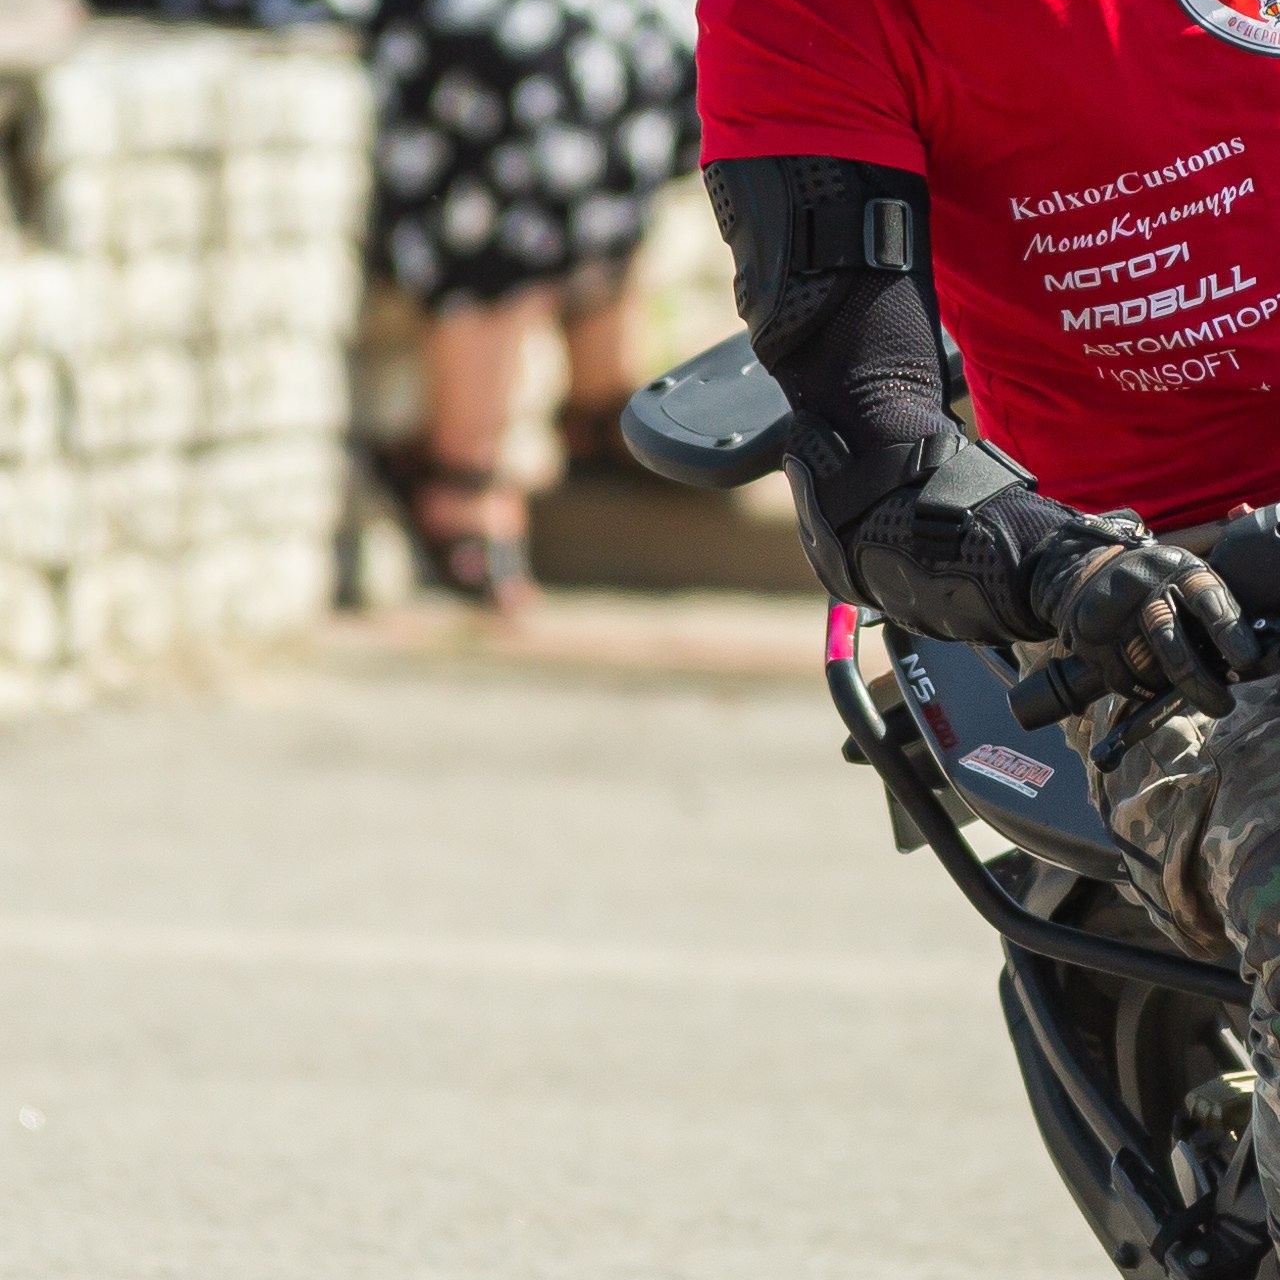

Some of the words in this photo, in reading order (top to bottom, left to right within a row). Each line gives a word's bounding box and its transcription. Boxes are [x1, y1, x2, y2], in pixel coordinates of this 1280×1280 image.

[1009, 135, 1246, 221] KolxozCustoms
[1023, 176, 1255, 261] МотоКультура
[1060, 264, 1257, 332] MADBULL
[900, 652, 936, 703] NS
